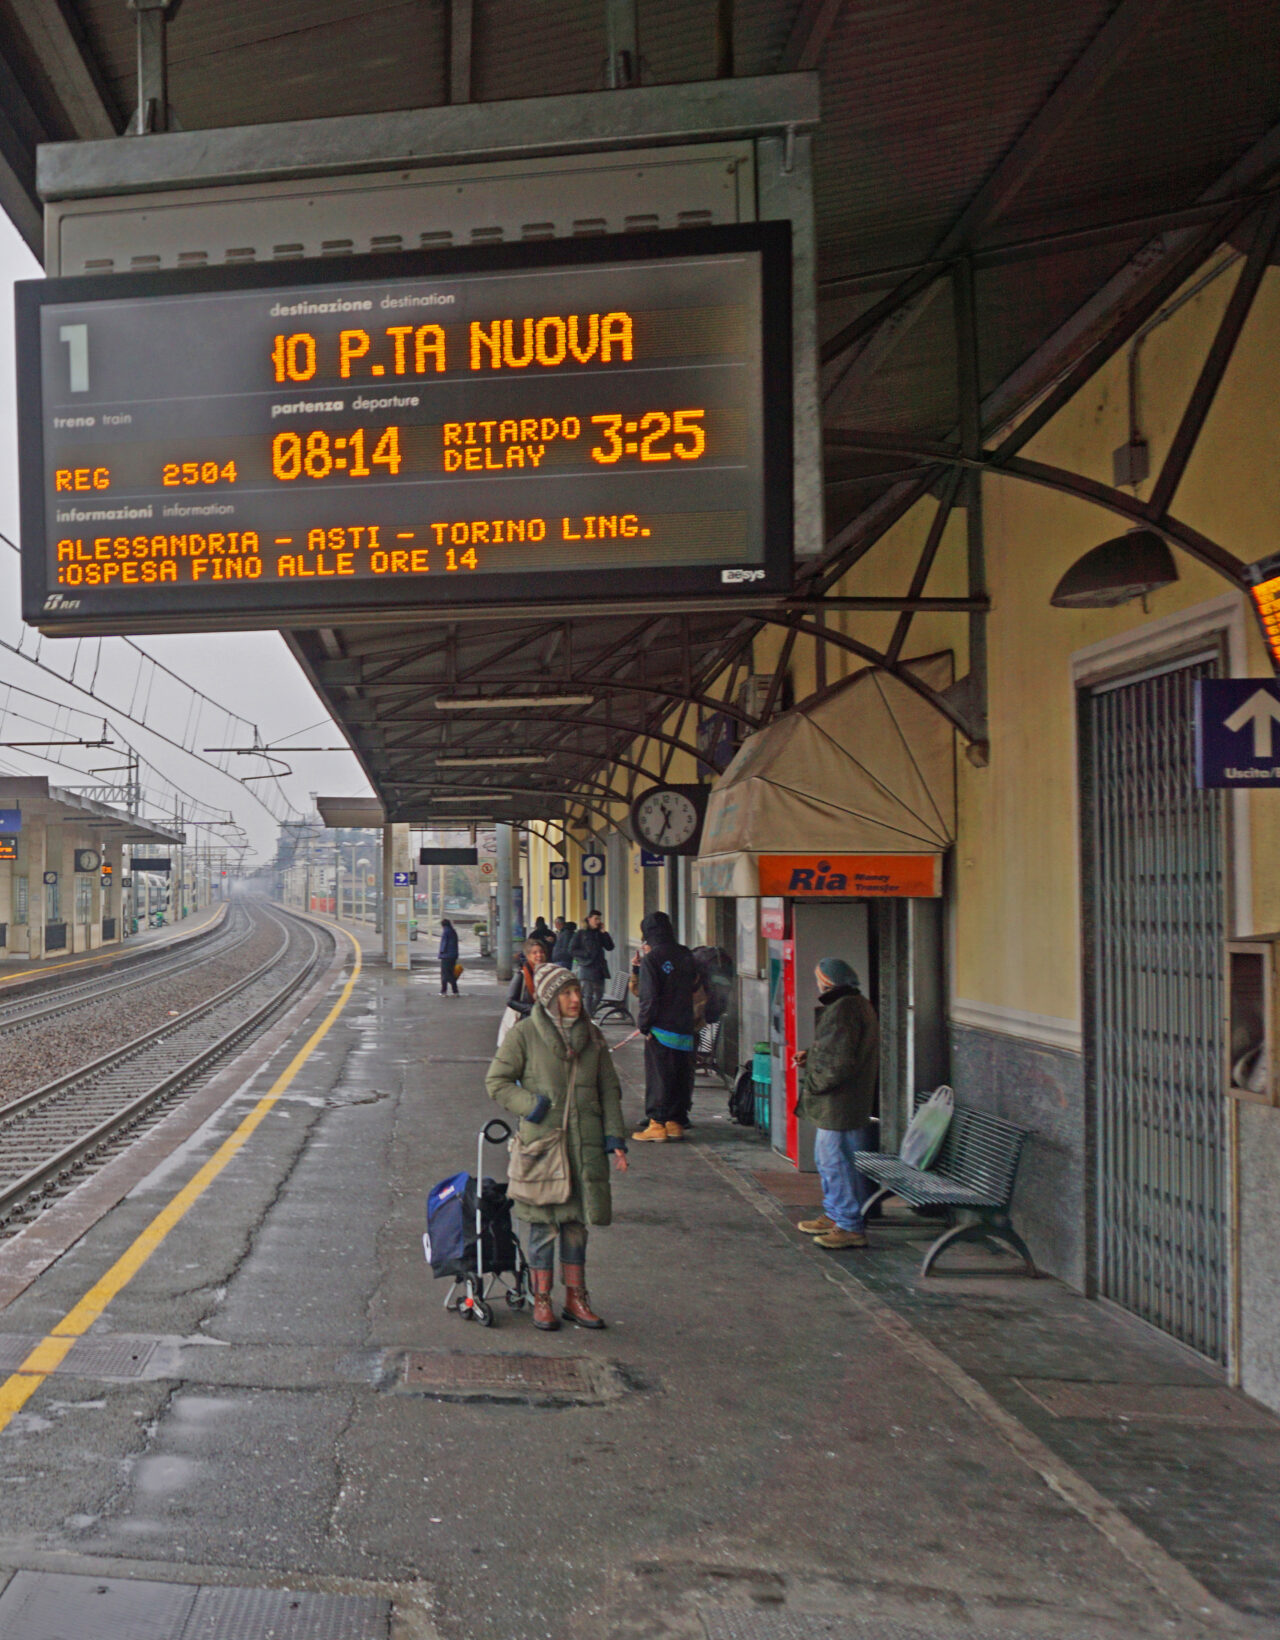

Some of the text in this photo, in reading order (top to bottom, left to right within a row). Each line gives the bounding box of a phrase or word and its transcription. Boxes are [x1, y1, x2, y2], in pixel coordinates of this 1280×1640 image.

[270, 293, 455, 317] destinazione destination
[59, 324, 89, 392] 1
[340, 325, 445, 378] P.TA
[470, 312, 632, 370] NUOVA
[53, 412, 132, 429] treno train
[271, 396, 420, 418] partenza departure
[444, 417, 580, 446] RITARDO
[591, 410, 705, 464] 3:25
[272, 427, 401, 480] 08:14
[444, 445, 545, 472] DELAY
[56, 461, 237, 491] REG 2504
[56, 503, 235, 522] informazioni information
[57, 532, 259, 561] ALESSANDRIA
[307, 526, 380, 551] ASTI
[431, 519, 545, 545] TORINO
[562, 515, 650, 540] LING.
[192, 556, 263, 582] FINO
[278, 553, 355, 577] ALLE
[371, 550, 429, 573] ORE
[446, 548, 478, 570] 14
[788, 860, 847, 891] Ria
